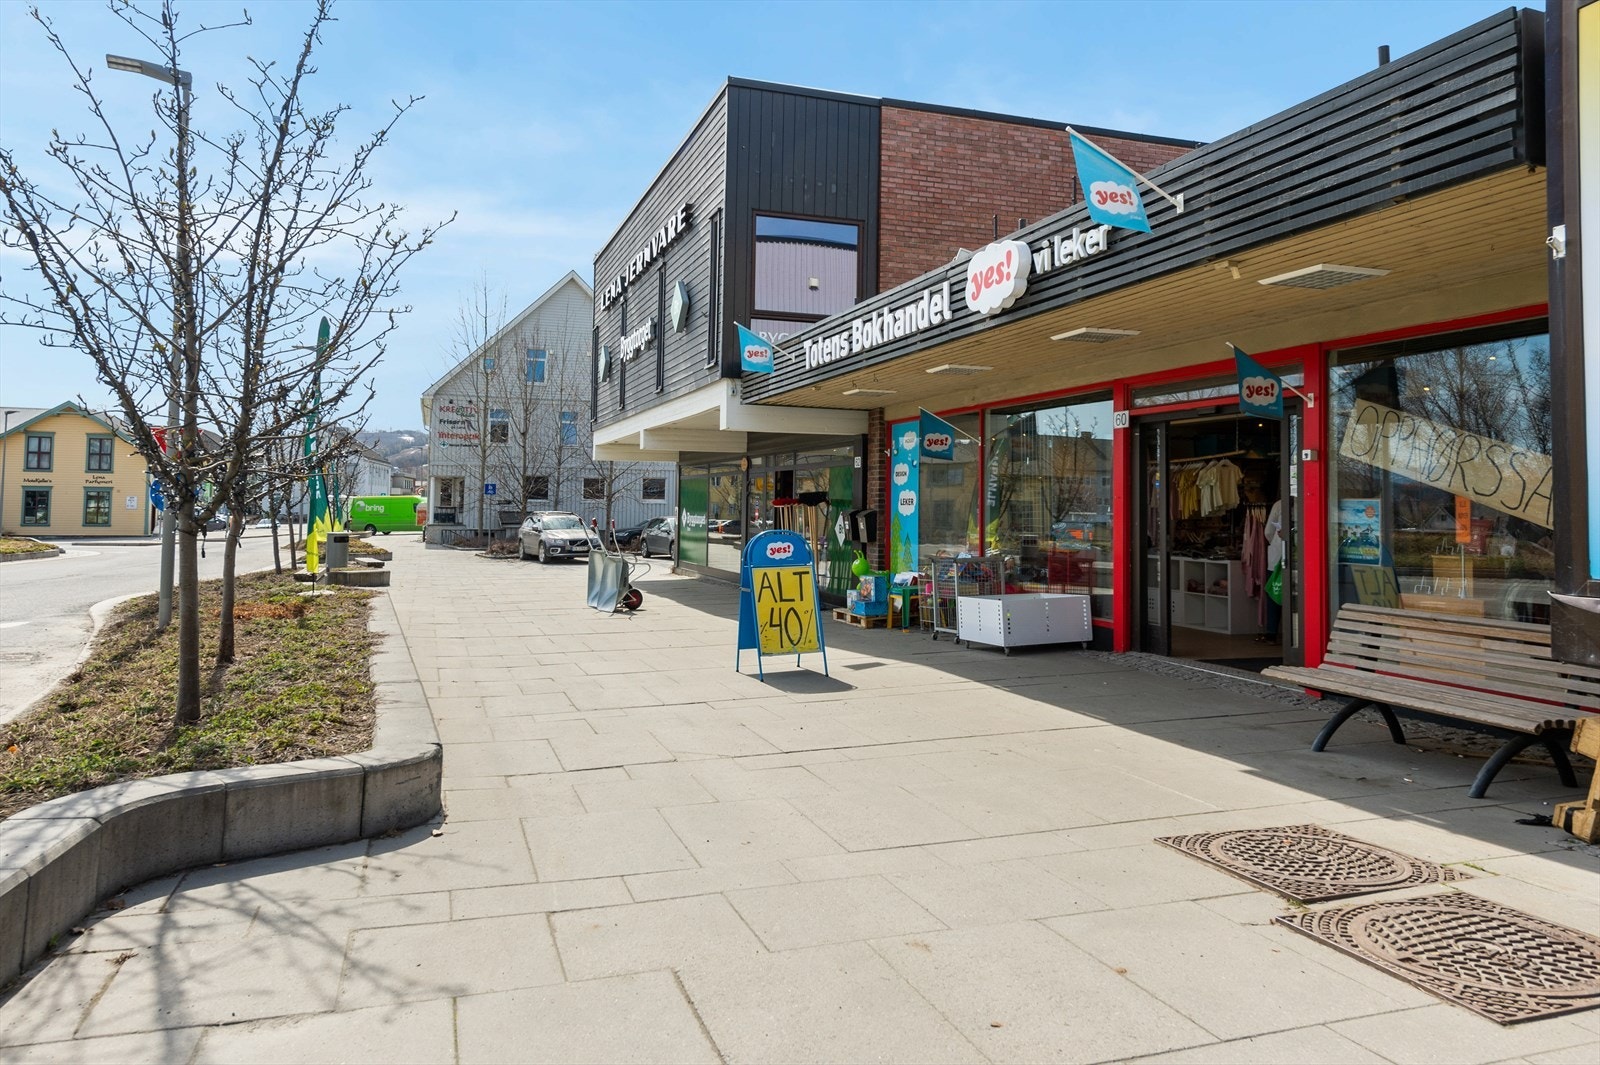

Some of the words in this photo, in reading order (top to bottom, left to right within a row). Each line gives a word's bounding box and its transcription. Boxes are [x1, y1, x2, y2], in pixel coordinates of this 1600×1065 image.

[1095, 189, 1134, 206] yes!
[600, 276, 622, 311] LENA
[624, 203, 686, 287] JERNVARE
[1033, 240, 1052, 274] vi
[1054, 224, 1112, 267] leker
[971, 249, 1012, 301] yes!
[803, 331, 850, 370] Totens
[852, 280, 953, 353] Bokhandel
[746, 349, 768, 358] yes!
[1245, 383, 1275, 399] yes!
[1116, 413, 1126, 426] 60
[926, 437, 948, 447] yes!
[365, 504, 385, 513] bring
[900, 498, 914, 506] LEKER
[769, 545, 791, 556] yes!
[757, 571, 809, 603] ALT
